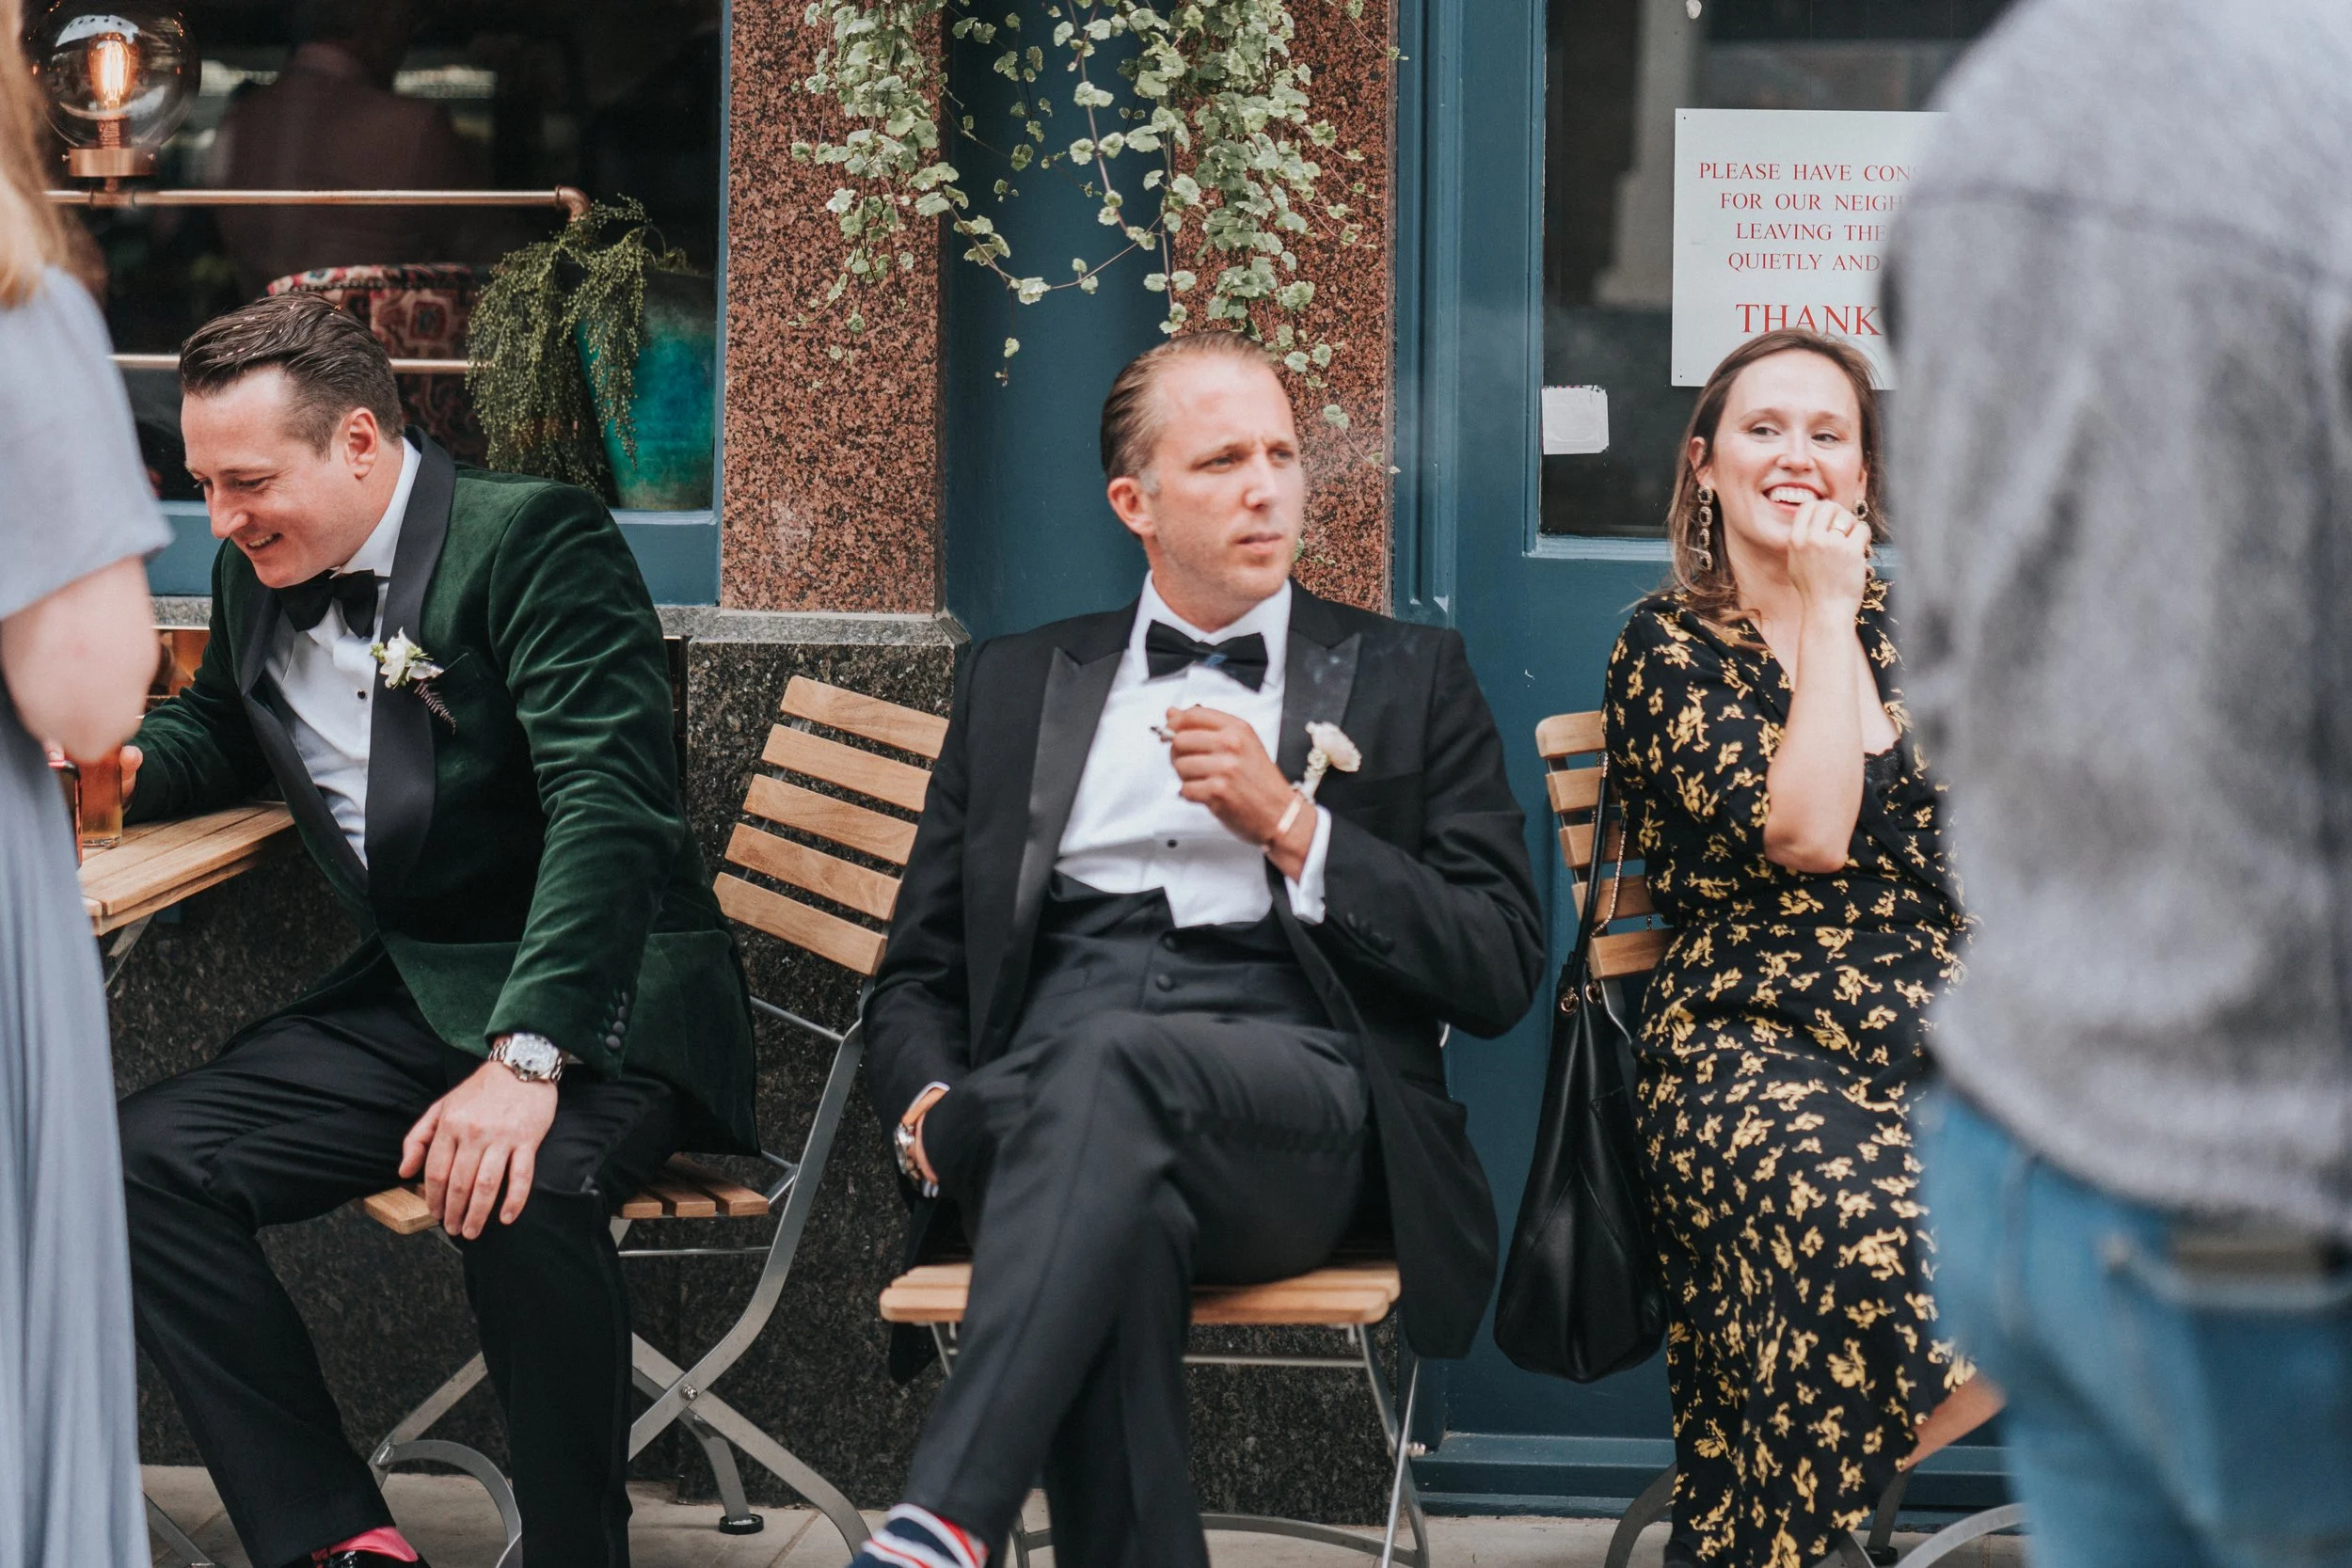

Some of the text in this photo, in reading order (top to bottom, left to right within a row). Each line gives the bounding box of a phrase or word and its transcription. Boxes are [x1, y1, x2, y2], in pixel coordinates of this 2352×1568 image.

[1699, 163, 1780, 180] PLEASE
[1793, 164, 1851, 181] HAVE
[1721, 193, 1763, 209] FOR
[1775, 194, 1822, 211] OUR
[1737, 223, 1886, 241] LEAVING THE
[1728, 253, 1880, 272] QUIETLY AND
[1736, 304, 1882, 335] THANK
